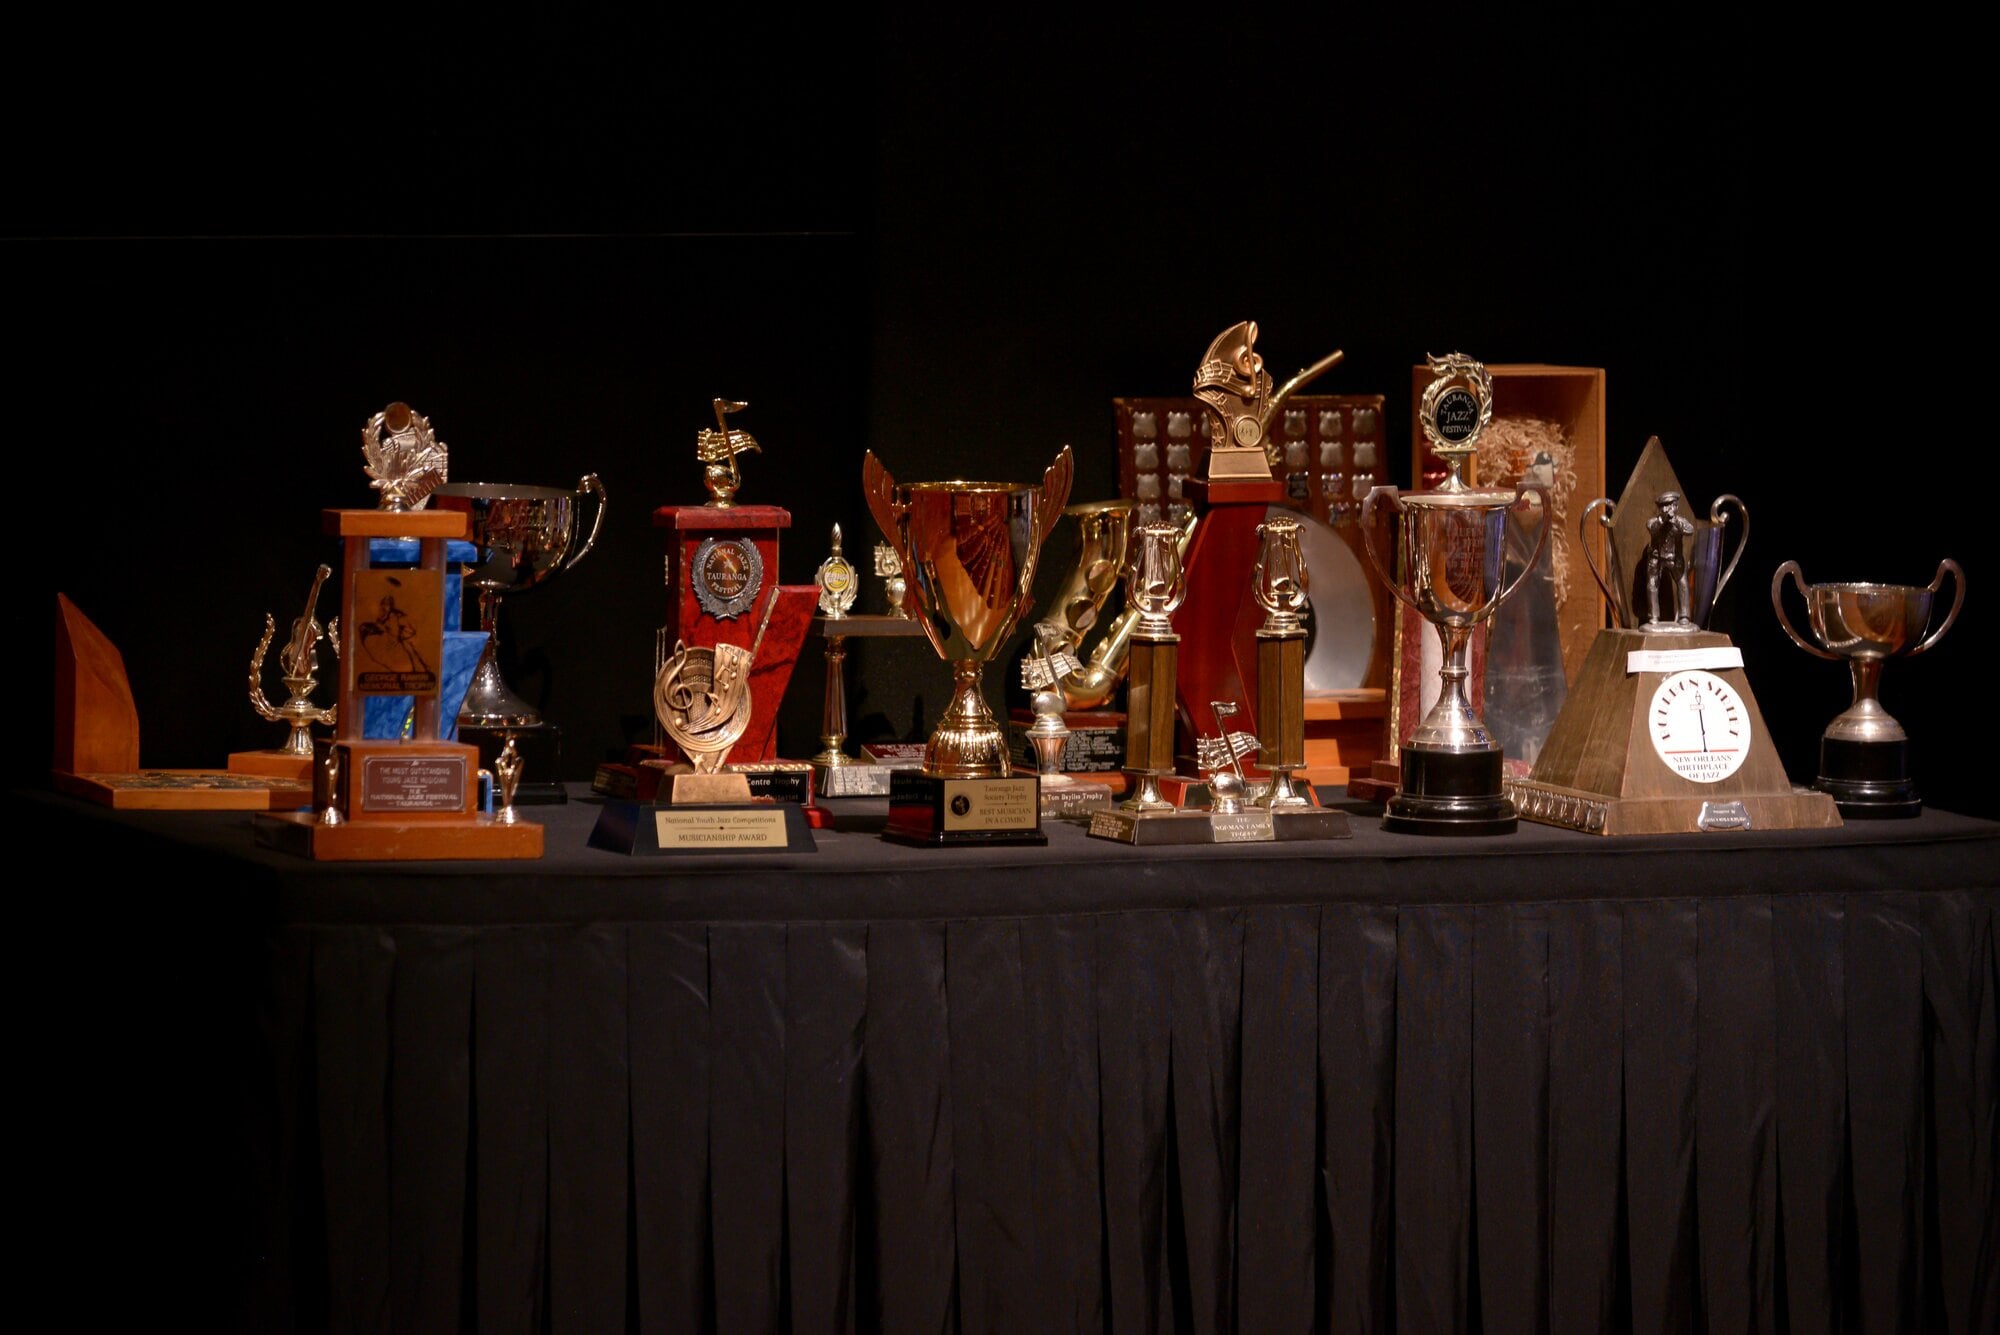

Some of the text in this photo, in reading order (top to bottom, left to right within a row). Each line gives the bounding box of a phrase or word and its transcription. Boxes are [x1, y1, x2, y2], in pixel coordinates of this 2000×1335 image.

[1440, 393, 1474, 416] TAURANGA
[1446, 410, 1469, 424] JAZZ
[1442, 424, 1472, 434] FESTIVAL
[706, 548, 750, 571] NATIONAL JAZZ
[707, 572, 747, 581] TAURANGA
[711, 581, 743, 594] FESTIVAL
[1673, 754, 1732, 763] NEW ORLEANS
[1677, 763, 1729, 772] BIRTHPLACE
[1702, 771, 1721, 780] JAZZ
[984, 784, 1025, 793] Tauranga Jazz
[984, 793, 1027, 802] Society Trophy
[1082, 792, 1103, 801] Trophy
[979, 808, 995, 816] BEST
[996, 807, 1032, 815] MUSICIAN
[665, 816, 776, 825] National Youth Jazz Competitions
[985, 816, 1026, 824] IN A COMBO
[678, 833, 767, 842] MUSICIANSHIP AWARD
